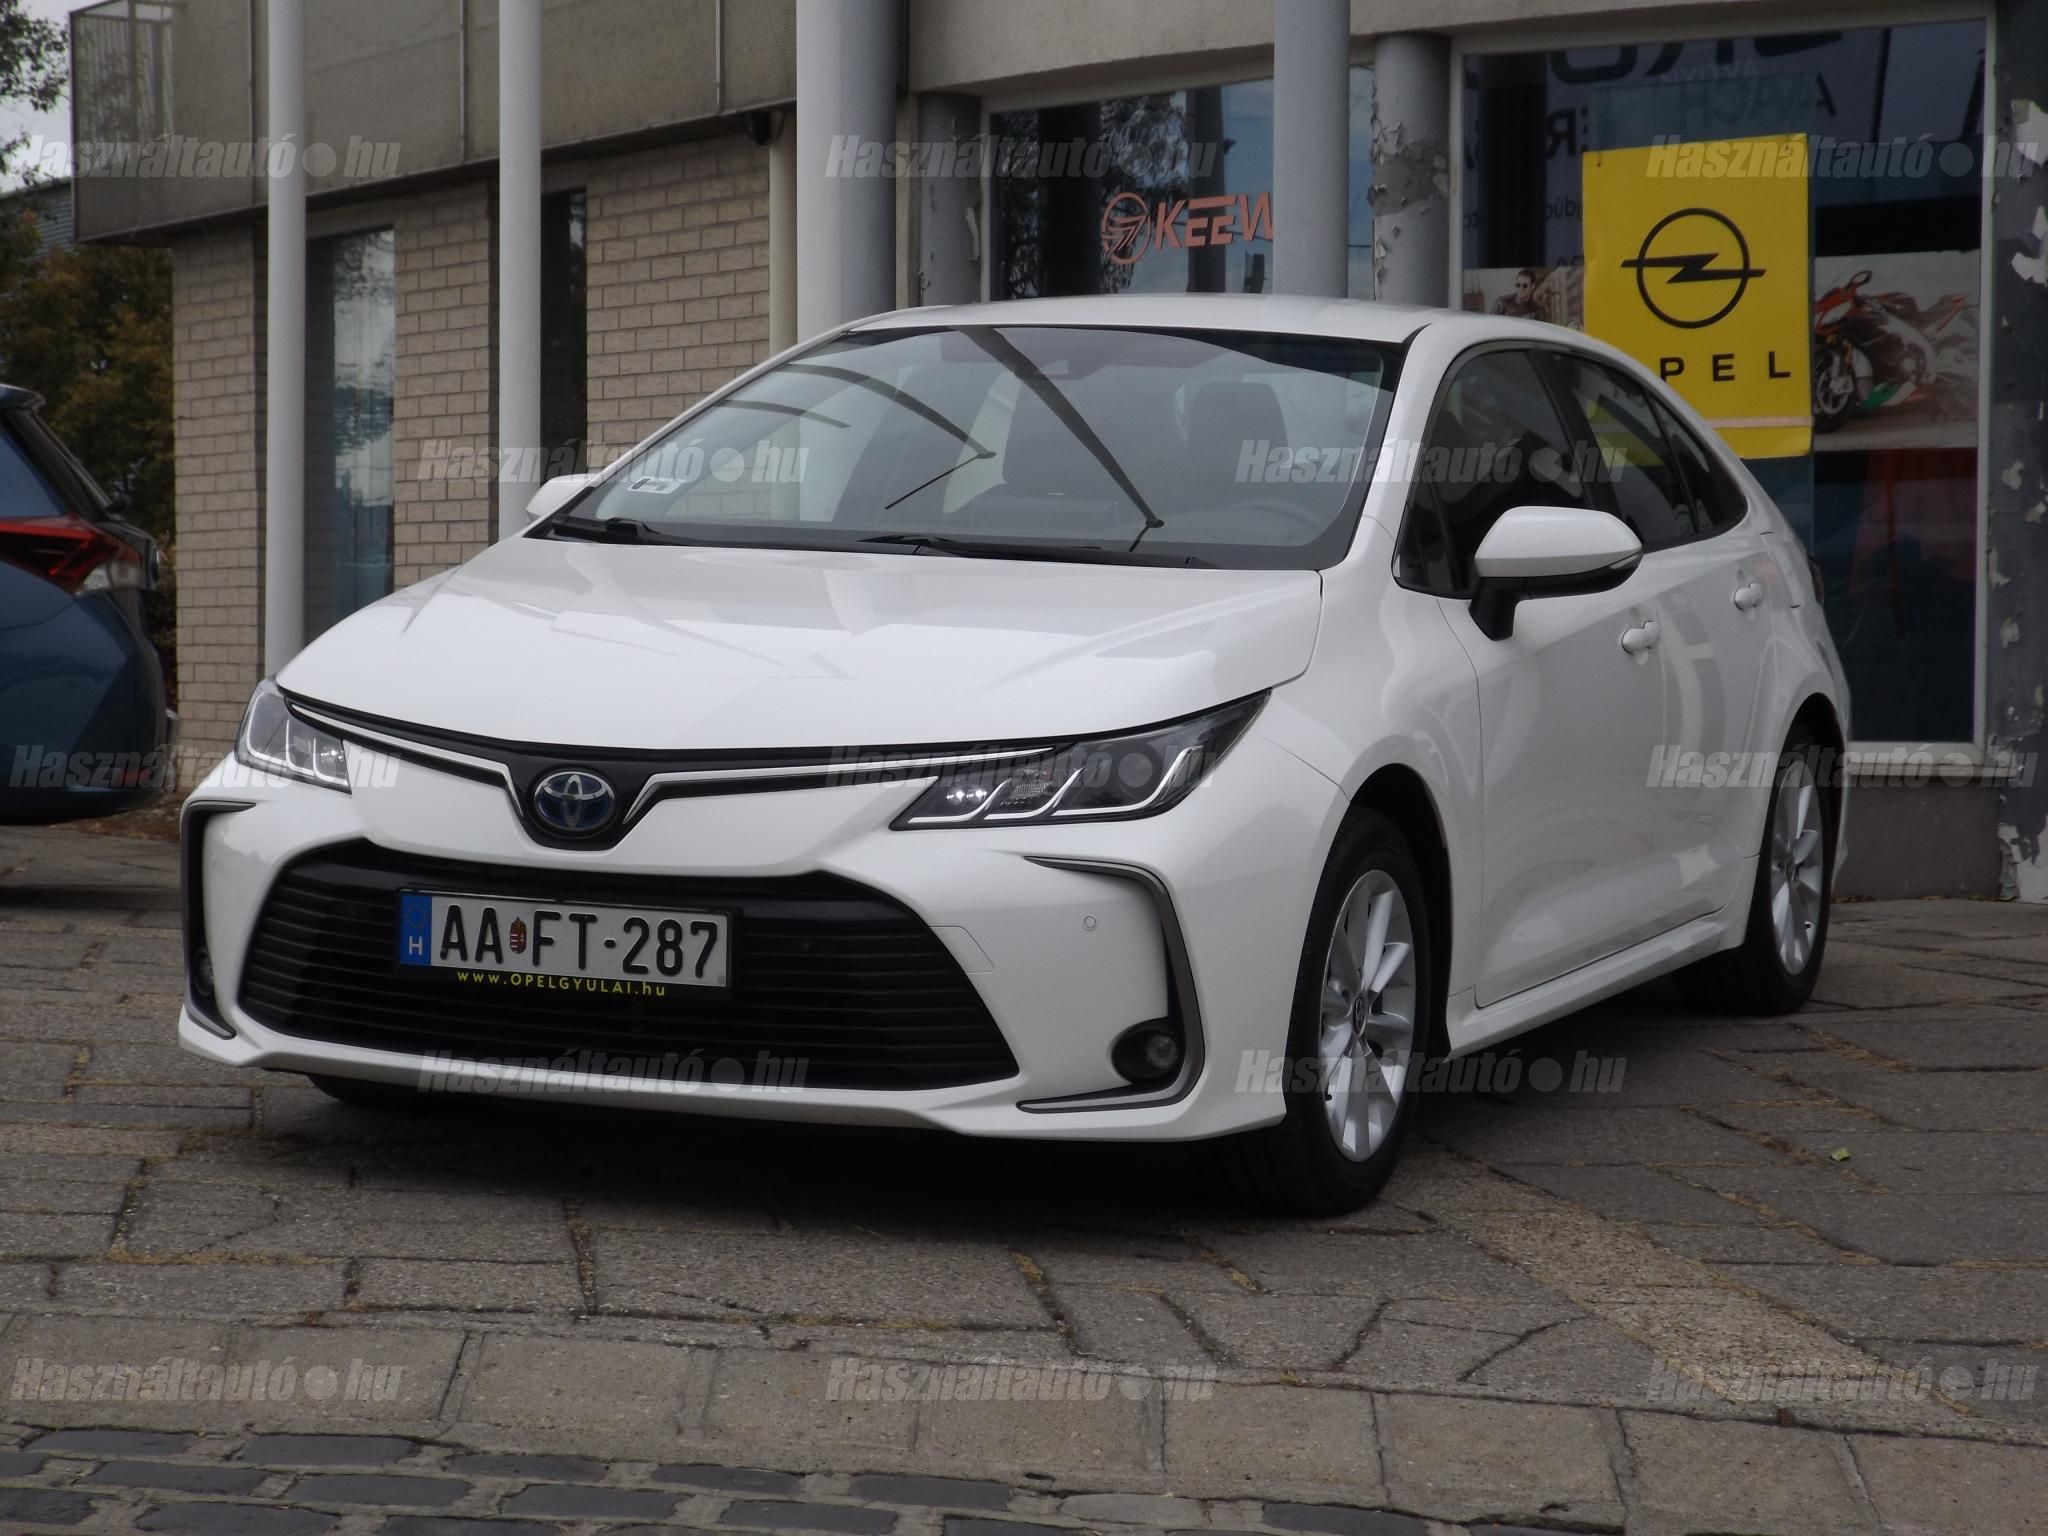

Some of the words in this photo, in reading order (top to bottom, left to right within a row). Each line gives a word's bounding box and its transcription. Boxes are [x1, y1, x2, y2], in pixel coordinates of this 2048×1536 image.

[1659, 350, 1792, 382] PEL
[408, 935, 423, 955] H
[440, 904, 504, 964] AA
[532, 910, 718, 978] FT-287
[457, 971, 666, 997] www.OPELGYULAI.hu
